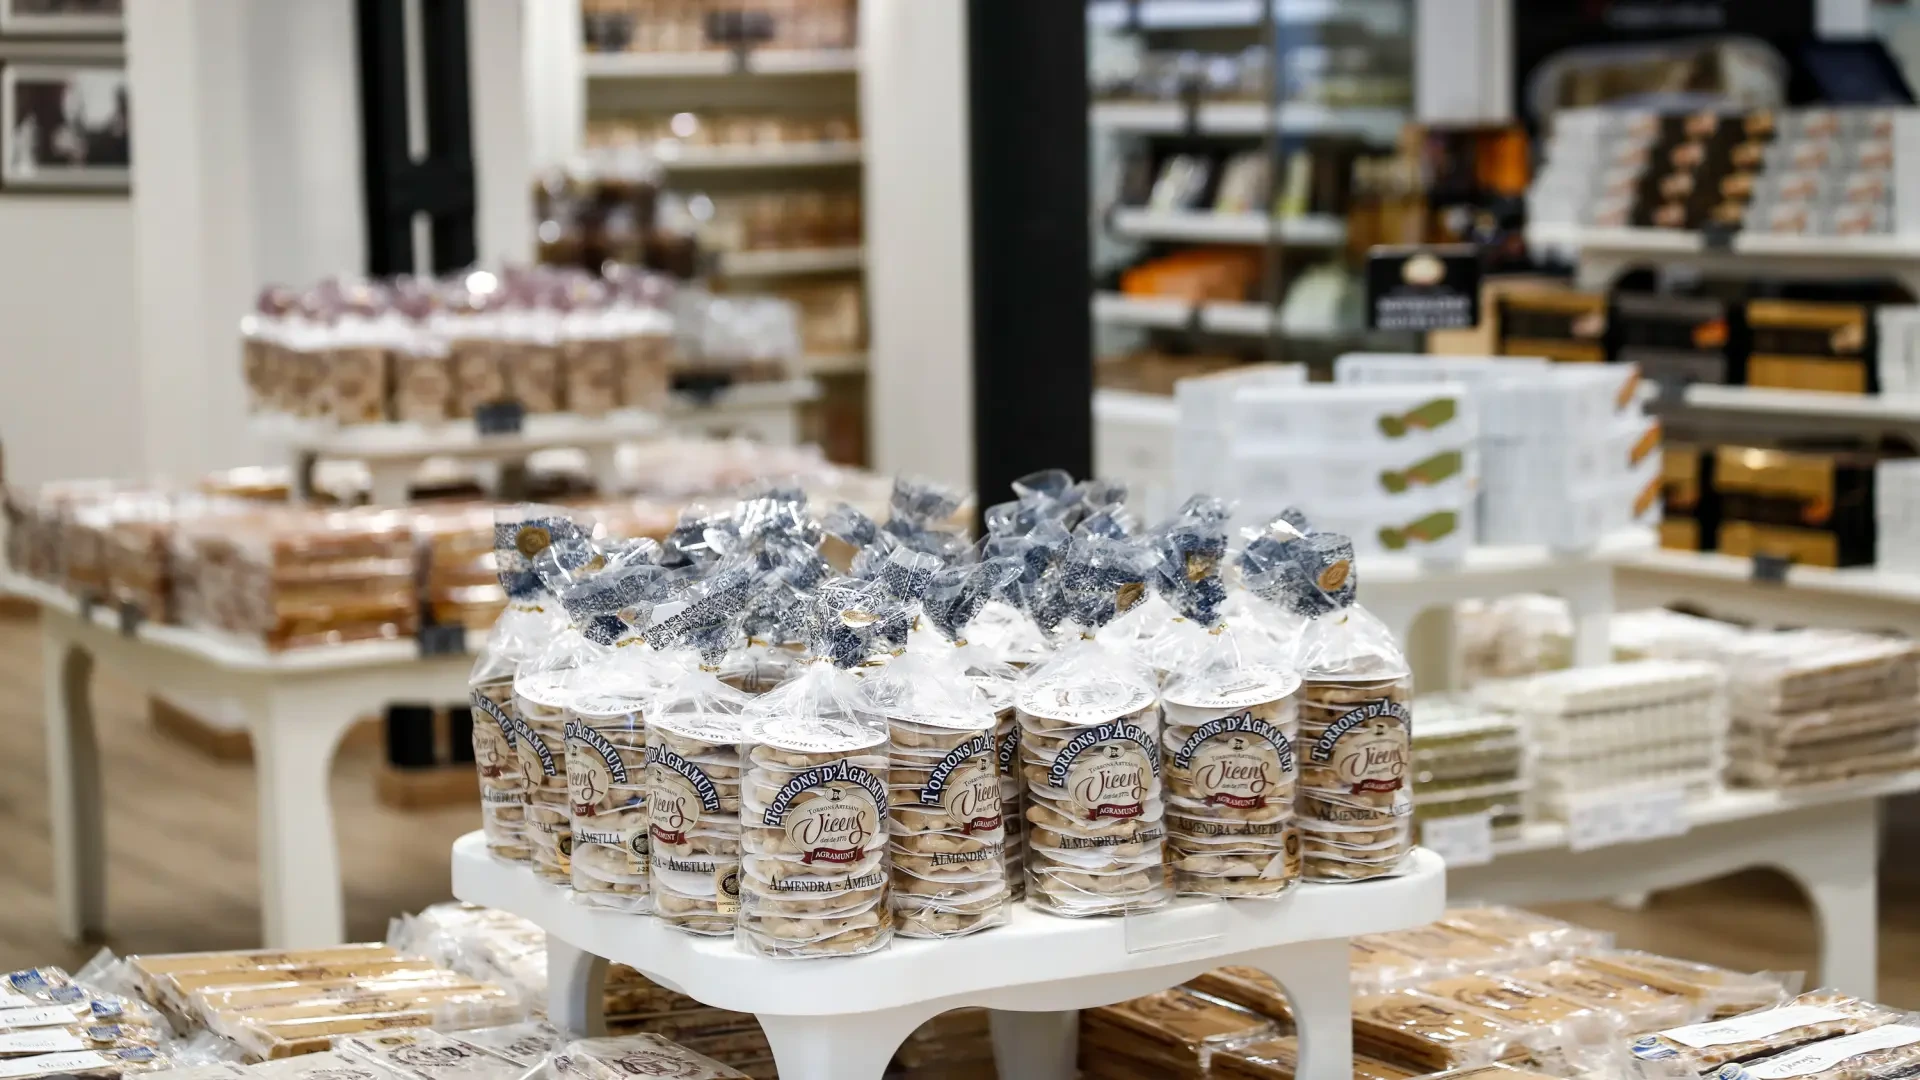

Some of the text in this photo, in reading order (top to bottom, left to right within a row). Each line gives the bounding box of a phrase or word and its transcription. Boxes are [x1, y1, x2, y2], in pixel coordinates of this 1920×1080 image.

[565, 718, 627, 784] D'AGRAMUNT
[1000, 726, 1018, 772] TORRO
[1175, 712, 1292, 772] TORRONS D'AGRAMUNT
[1312, 709, 1364, 761] TORRONS
[1048, 719, 1160, 788] TORRONS D'AGRAMUNT
[650, 744, 720, 811] D'AGRAMUNT
[921, 744, 971, 806] TORRONS
[1075, 767, 1148, 802] Vicens
[1196, 761, 1274, 793] Vicens
[764, 760, 887, 826] TORRONS D'AGRAMUNT
[951, 778, 1001, 816] Vicens
[1099, 806, 1139, 815] AGRAMUNT
[1216, 796, 1256, 806] AGRAMUNT
[579, 828, 621, 844] AMETLLA
[792, 810, 871, 845] Vicens
[1059, 834, 1119, 849] ALMENDRA
[1178, 817, 1231, 836] ALMENDRA
[668, 856, 716, 873] AMETLLA
[815, 851, 855, 861] AGRAMUNT
[930, 848, 988, 867] ALMENDRA
[770, 875, 833, 892] ALMENDRA
[844, 872, 883, 889] AMETLLA
